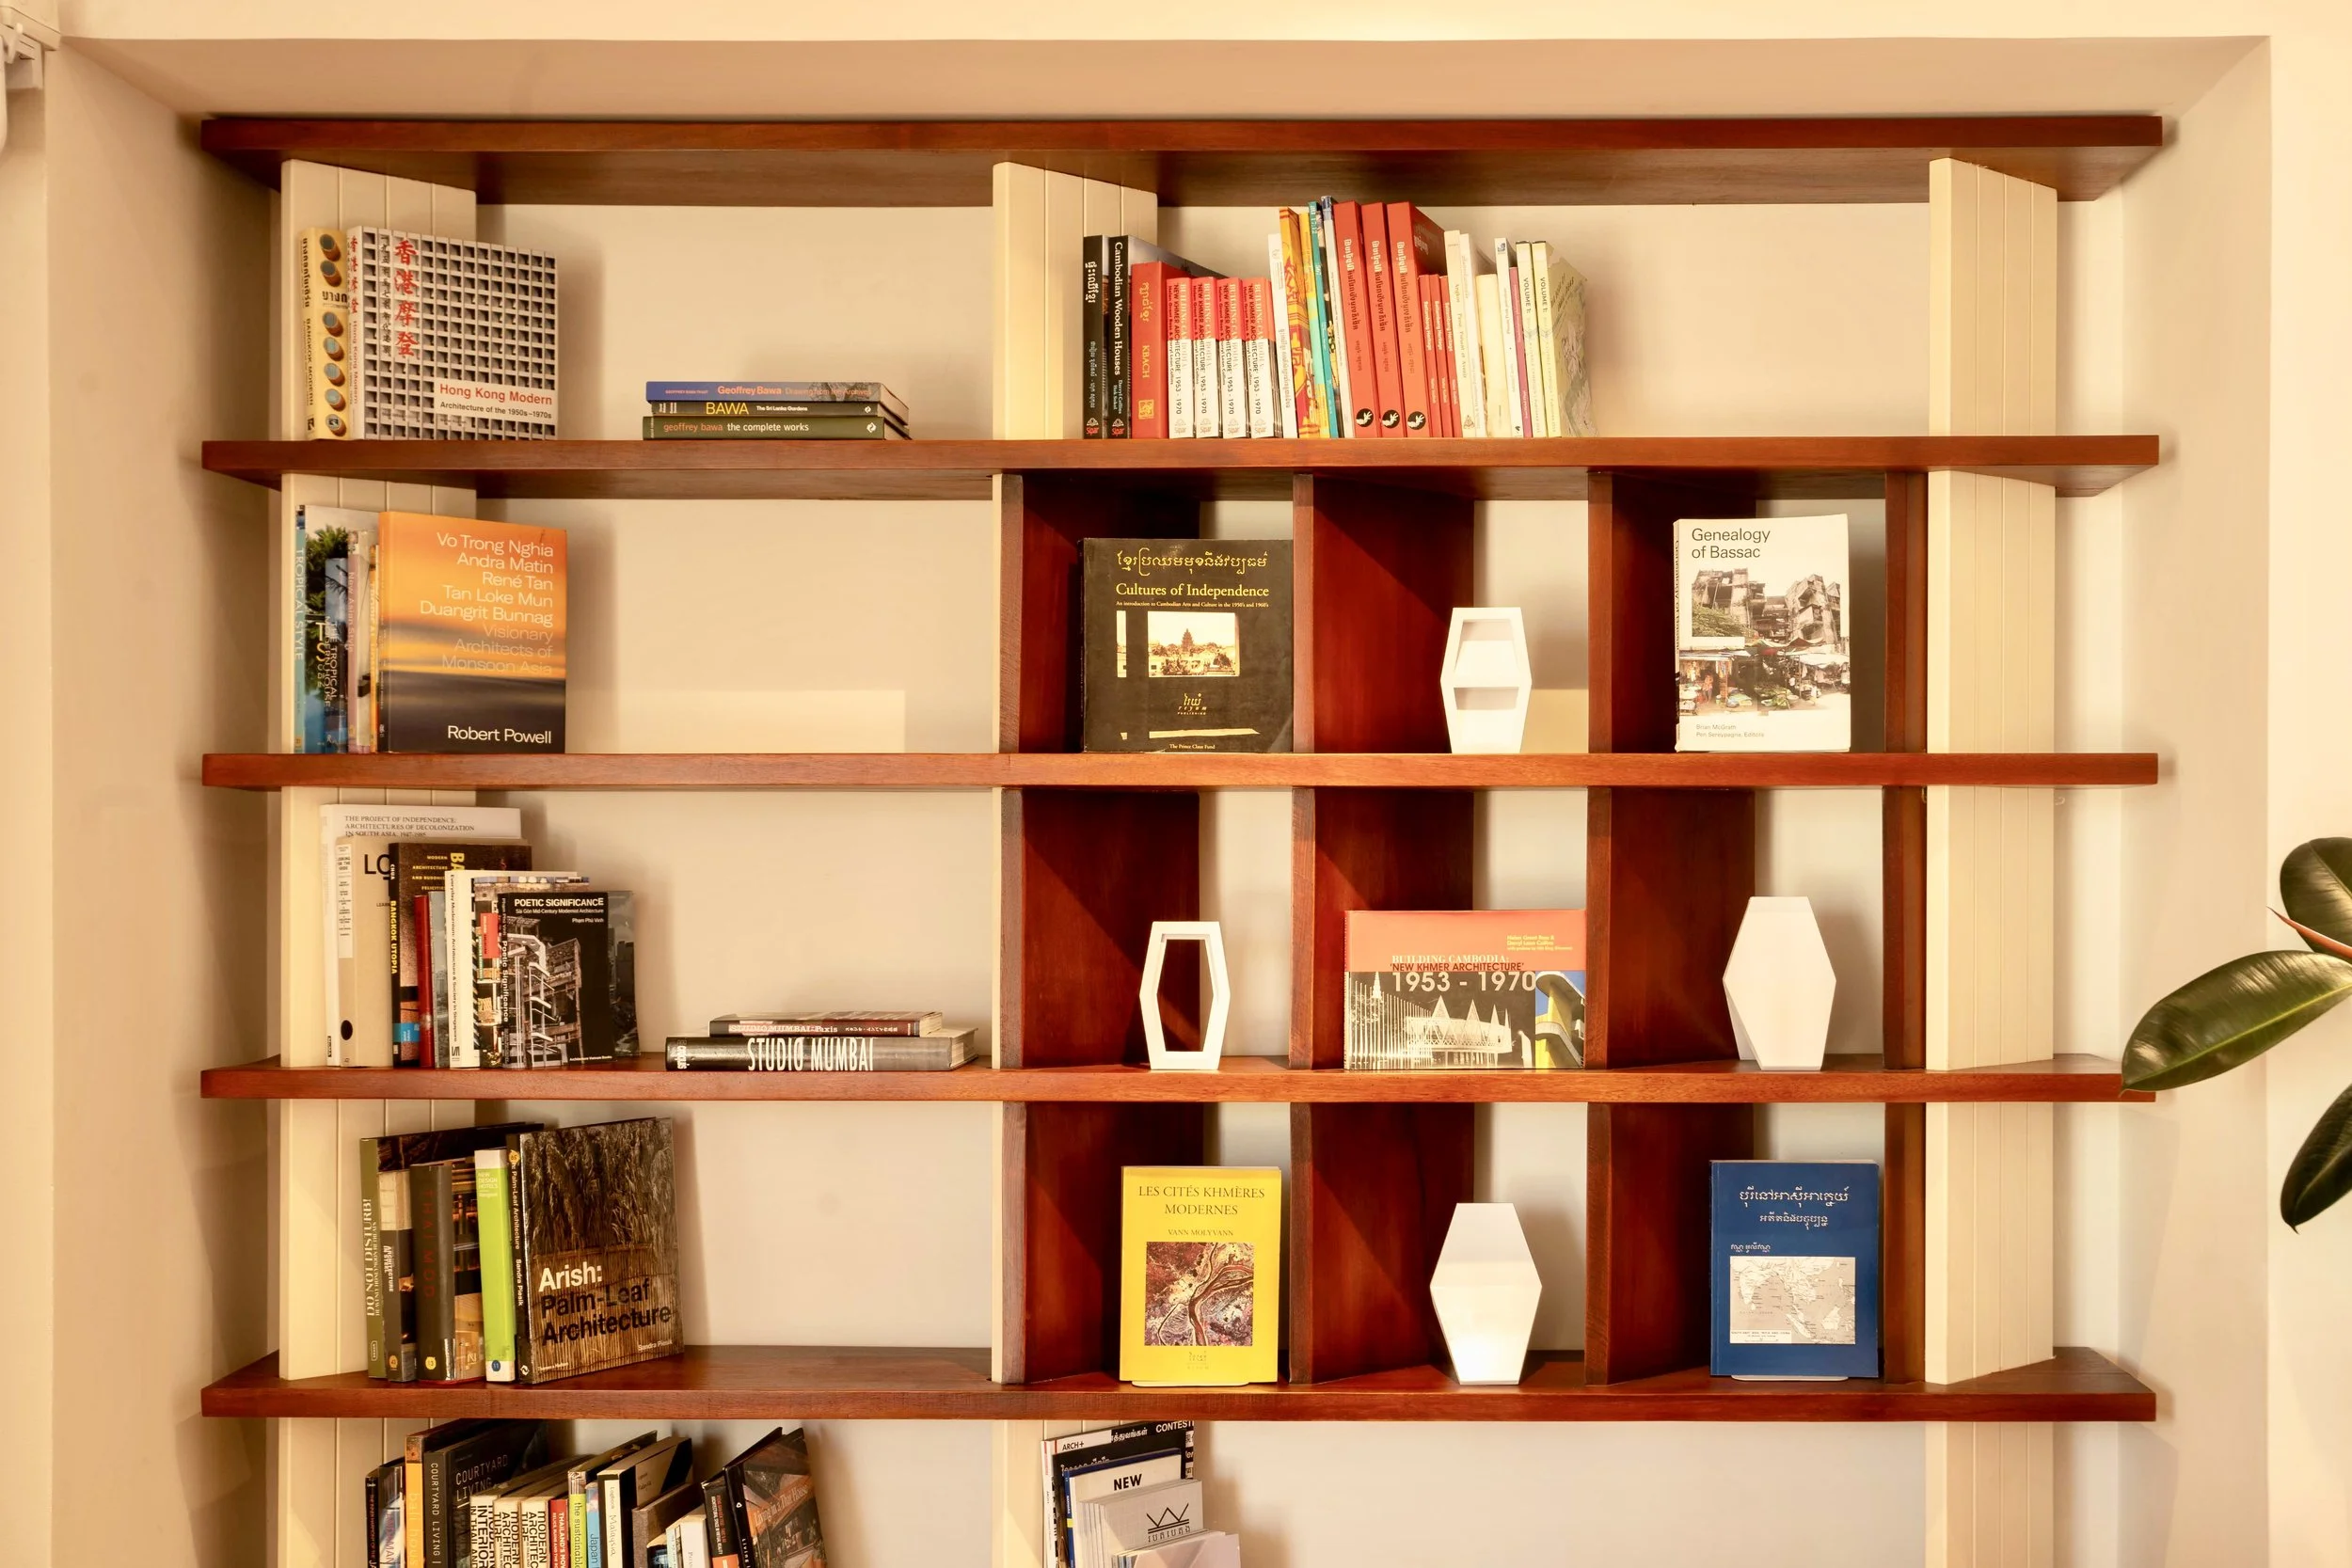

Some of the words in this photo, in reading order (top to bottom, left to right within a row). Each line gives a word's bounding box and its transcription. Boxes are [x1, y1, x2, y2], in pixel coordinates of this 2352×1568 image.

[1115, 242, 1123, 297] Cambodian
[394, 240, 420, 357] 香港摩登
[1114, 298, 1123, 339] Wooden
[1114, 341, 1123, 375] Houses
[440, 383, 471, 400] Hong
[476, 387, 505, 403] Kong
[509, 390, 552, 405] Modern
[718, 386, 755, 395] Geoffrey
[757, 386, 782, 394] Bawa
[440, 402, 484, 413] Architecture
[706, 403, 749, 415] BAWA
[663, 422, 698, 433] geoffrey
[701, 422, 723, 431] bawa
[727, 422, 740, 431] the
[743, 422, 781, 433] complete
[784, 422, 809, 432] works
[437, 531, 458, 547] Vo
[460, 534, 505, 555] Trong
[509, 540, 554, 558] Nghia
[1692, 528, 1771, 544] Genealogy
[456, 553, 505, 569] Andra
[510, 558, 553, 574] Matin
[1692, 546, 1706, 559] of
[1710, 546, 1761, 559] Bassac
[295, 546, 306, 609] TROPICAL
[483, 571, 522, 587] René
[527, 576, 553, 591] Tan
[442, 584, 471, 600] Tan
[477, 588, 514, 604] Loke
[518, 592, 553, 608] Mun
[1116, 583, 1167, 596] Cultures
[1170, 583, 1184, 596] of
[1187, 584, 1269, 599] Independence
[421, 600, 487, 621] Duangrit
[493, 606, 553, 627] Bunnag
[295, 620, 305, 659] STYLE
[484, 623, 553, 643] Visionary
[454, 638, 533, 657] Architects
[537, 644, 553, 657] of
[442, 655, 515, 673] Monsoon
[520, 660, 552, 674] Asia
[447, 724, 500, 742] Robert
[504, 727, 552, 745] Powell
[515, 898, 544, 907] POETIC
[546, 897, 604, 907] SIGNIFICANCE
[1391, 955, 1445, 963] BUILDING
[1448, 955, 1509, 963] CAMBODIA:
[1417, 963, 1450, 972] KHMER
[1391, 972, 1451, 992] 1953
[1478, 971, 1536, 991] 1970
[747, 1037, 804, 1071] STUDIO
[811, 1037, 874, 1071] MUMBAI
[1138, 1186, 1160, 1196] LES
[1164, 1184, 1200, 1197] CITÉS
[1203, 1185, 1264, 1198] KHMÈRES
[422, 1189, 434, 1238] THAI
[1165, 1204, 1238, 1215] MODERNES
[363, 1198, 373, 1261] DISTURB!
[1191, 1228, 1233, 1237] MOLYVANN
[365, 1267, 374, 1292] NOT
[423, 1250, 435, 1298] MOD
[539, 1262, 603, 1291] Arish:
[366, 1296, 374, 1316] DO
[542, 1279, 650, 1319] Palm-Leaf
[543, 1304, 672, 1346] Architecture
[1062, 1441, 1085, 1450] ARCH+
[455, 1455, 509, 1485] COURTYARD
[431, 1463, 440, 1515] COURTYARD
[1114, 1473, 1142, 1491] NEW
[408, 1493, 421, 1520] bali
[432, 1521, 441, 1557] LIVING
[511, 1512, 520, 1565] MODERN
[538, 1512, 547, 1563] MODERN
[591, 1533, 599, 1564] Japan
